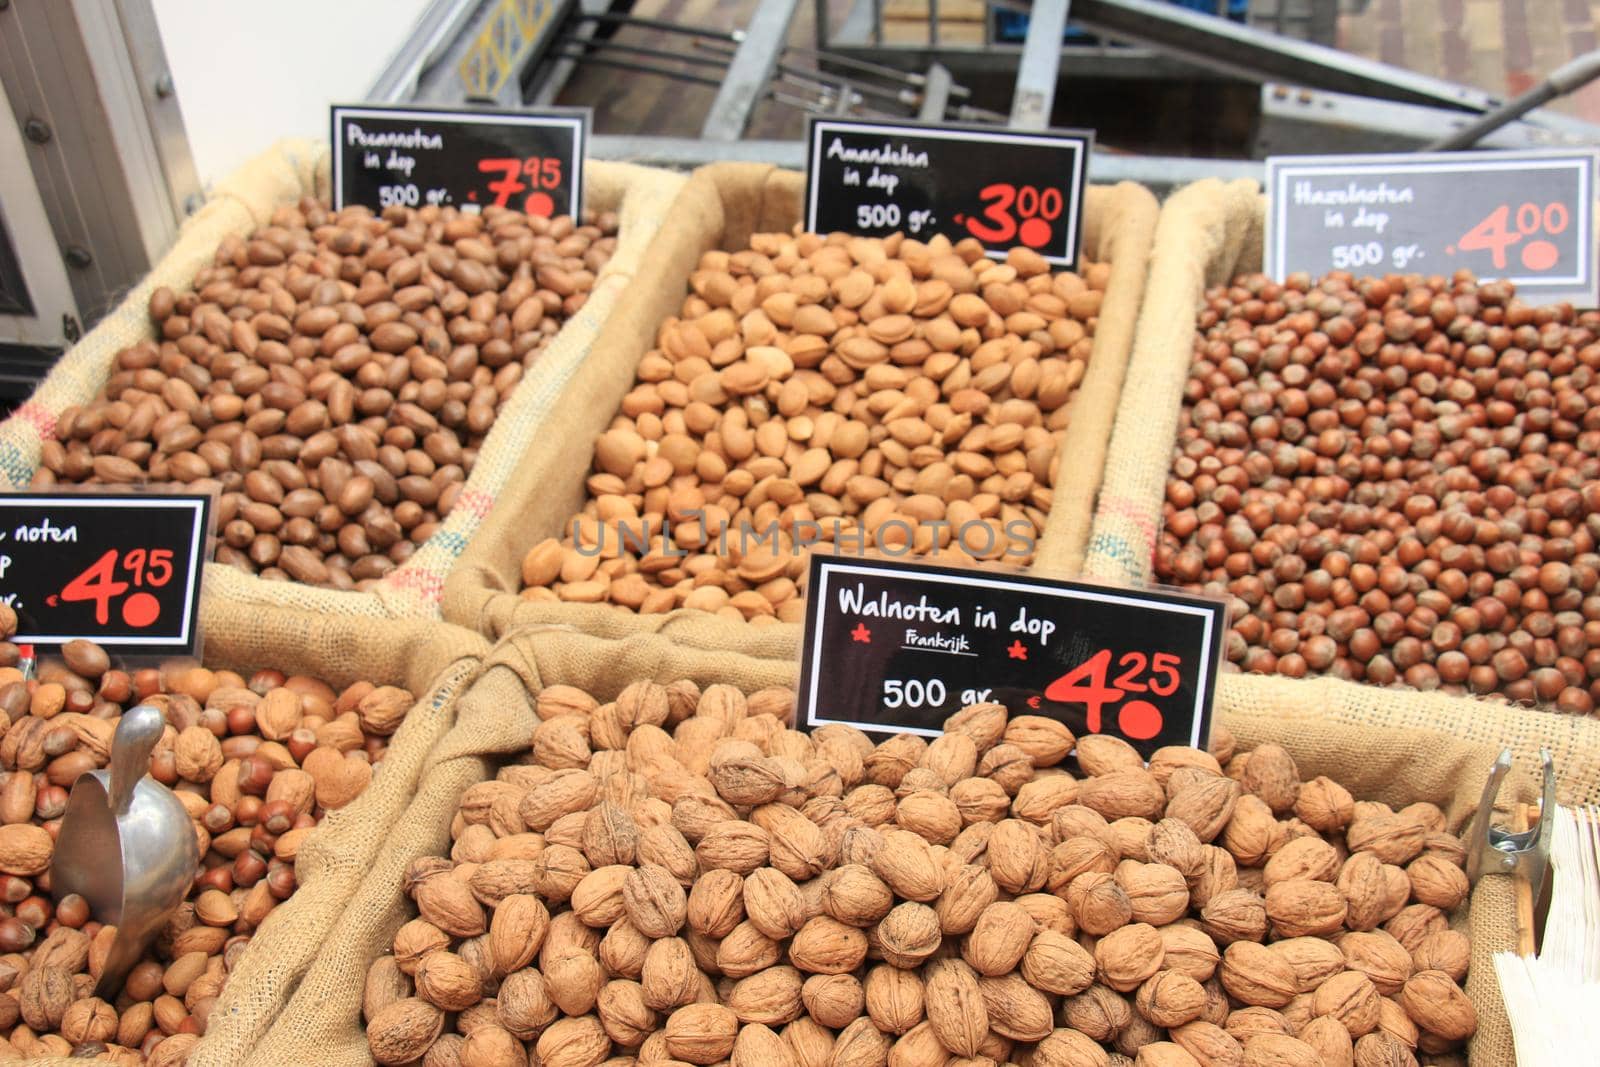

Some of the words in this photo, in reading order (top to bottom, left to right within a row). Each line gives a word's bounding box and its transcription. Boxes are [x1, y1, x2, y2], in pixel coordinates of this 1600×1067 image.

[347, 122, 443, 150] Pecannoten
[364, 151, 380, 169] in
[386, 149, 416, 177] dop
[827, 137, 929, 168] Amandelen
[843, 166, 860, 186] in
[866, 166, 899, 196] dop
[379, 184, 420, 208] 500
[857, 203, 901, 229] 500
[908, 209, 937, 233] gr.
[1324, 208, 1344, 228] in
[1352, 206, 1389, 234] dop
[1332, 241, 1384, 268] 500
[15, 517, 77, 542] noten
[838, 582, 961, 625] Walnoten
[974, 605, 997, 630] in
[1009, 606, 1056, 646] dop
[905, 628, 970, 653] Frankrijk
[883, 678, 947, 708] 500
